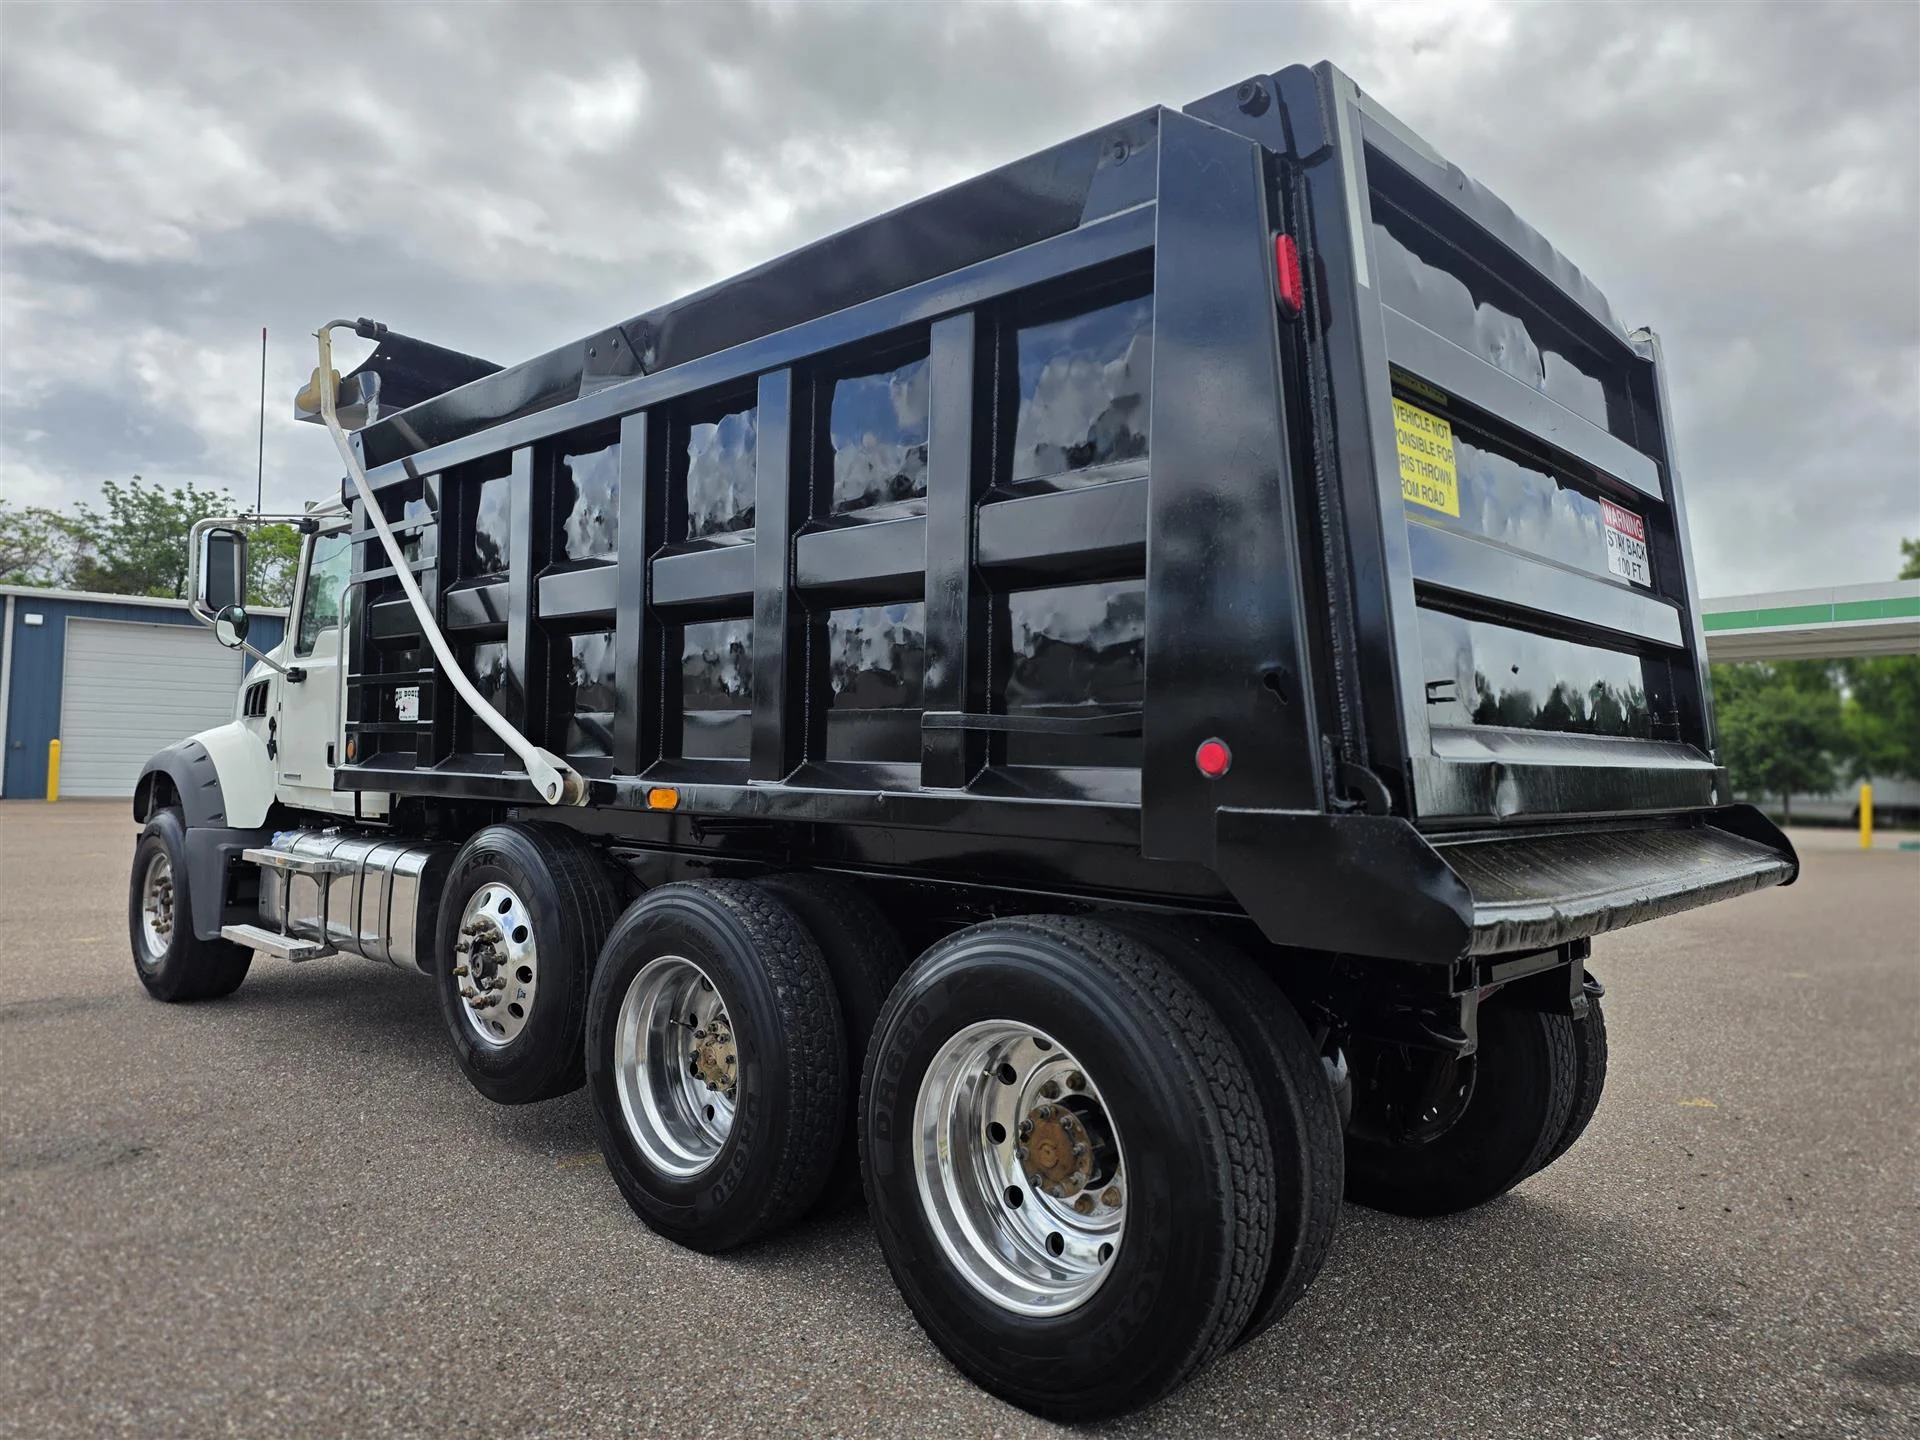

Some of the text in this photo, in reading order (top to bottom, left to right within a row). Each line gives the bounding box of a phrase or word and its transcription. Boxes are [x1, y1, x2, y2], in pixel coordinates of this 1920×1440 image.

[1394, 403, 1449, 441] VEHICLE NOT
[1396, 429, 1455, 465] ONSIBLE FOR
[1416, 459, 1452, 486] THROWN
[1422, 485, 1445, 507] ROAD
[1602, 502, 1643, 538] WARNING
[1607, 529, 1647, 562] STAY BACK
[1618, 556, 1630, 577] 100
